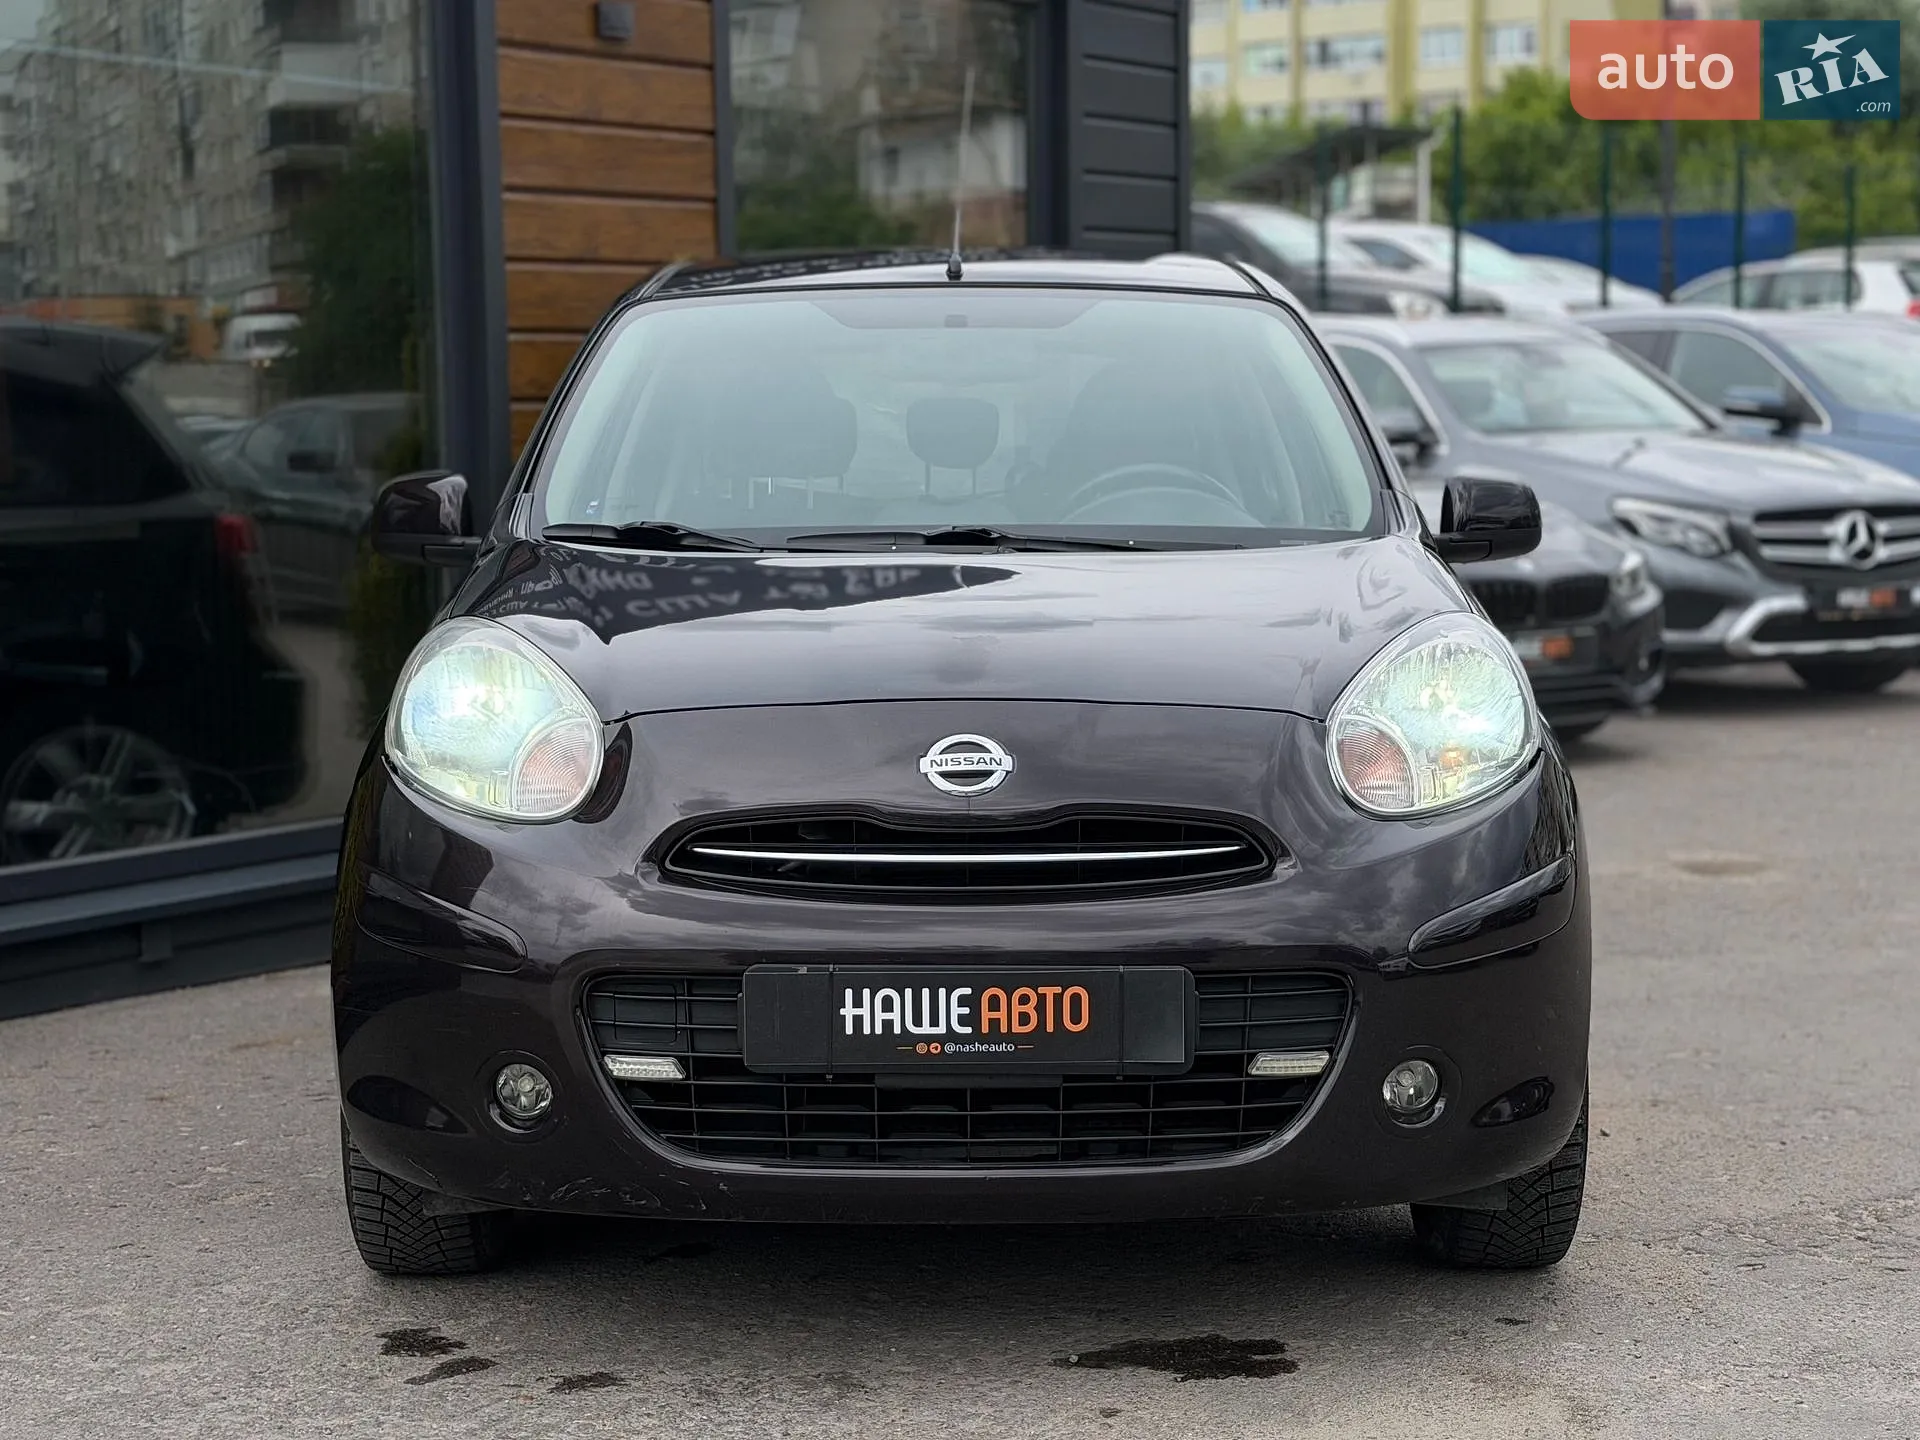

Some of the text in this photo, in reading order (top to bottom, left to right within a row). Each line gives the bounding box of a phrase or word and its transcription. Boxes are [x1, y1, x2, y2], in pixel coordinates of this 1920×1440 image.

[930, 756, 1003, 769] NISSAN
[839, 986, 1089, 1035] НАШЕ АВТО
[944, 1042, 1015, 1054] @nasheauto
